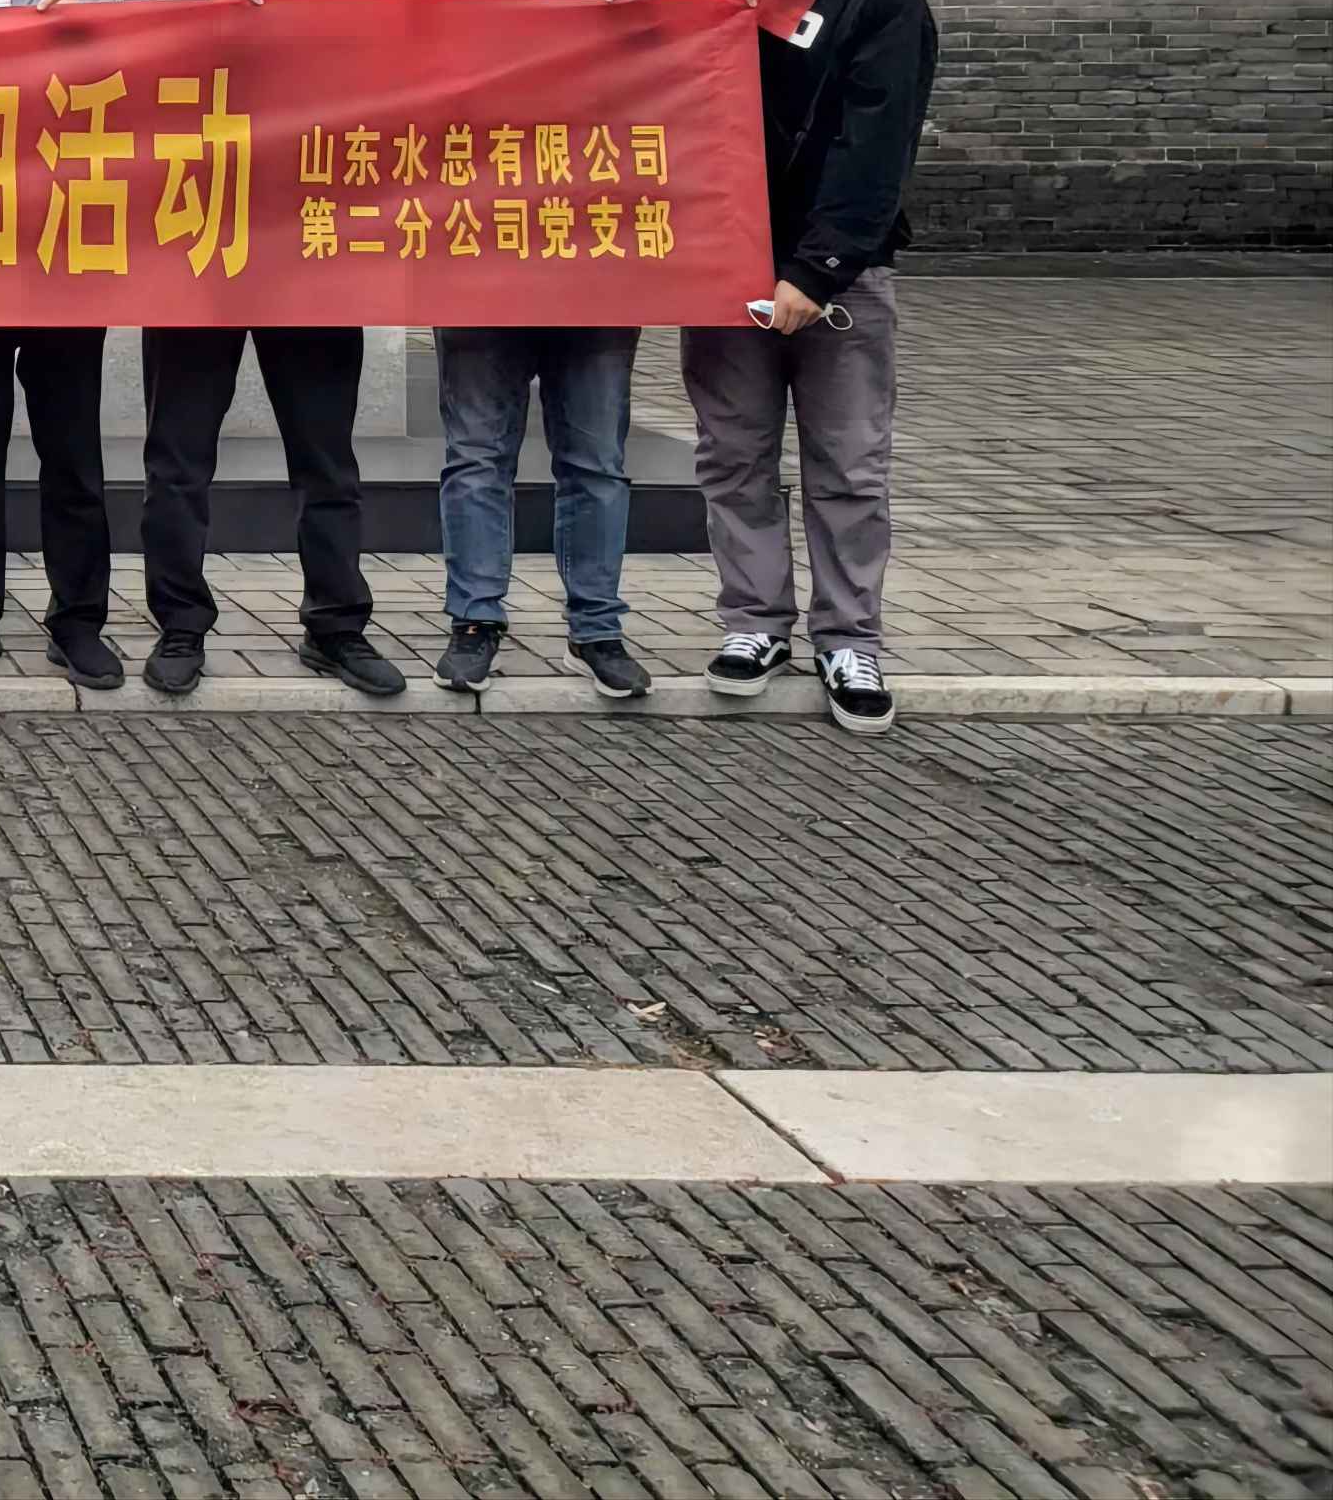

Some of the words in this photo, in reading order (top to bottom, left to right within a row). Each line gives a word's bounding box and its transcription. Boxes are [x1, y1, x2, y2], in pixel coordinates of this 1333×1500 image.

[299, 123, 668, 188] 山东水总有限公司
[299, 195, 676, 261] 第二分公司党支部
